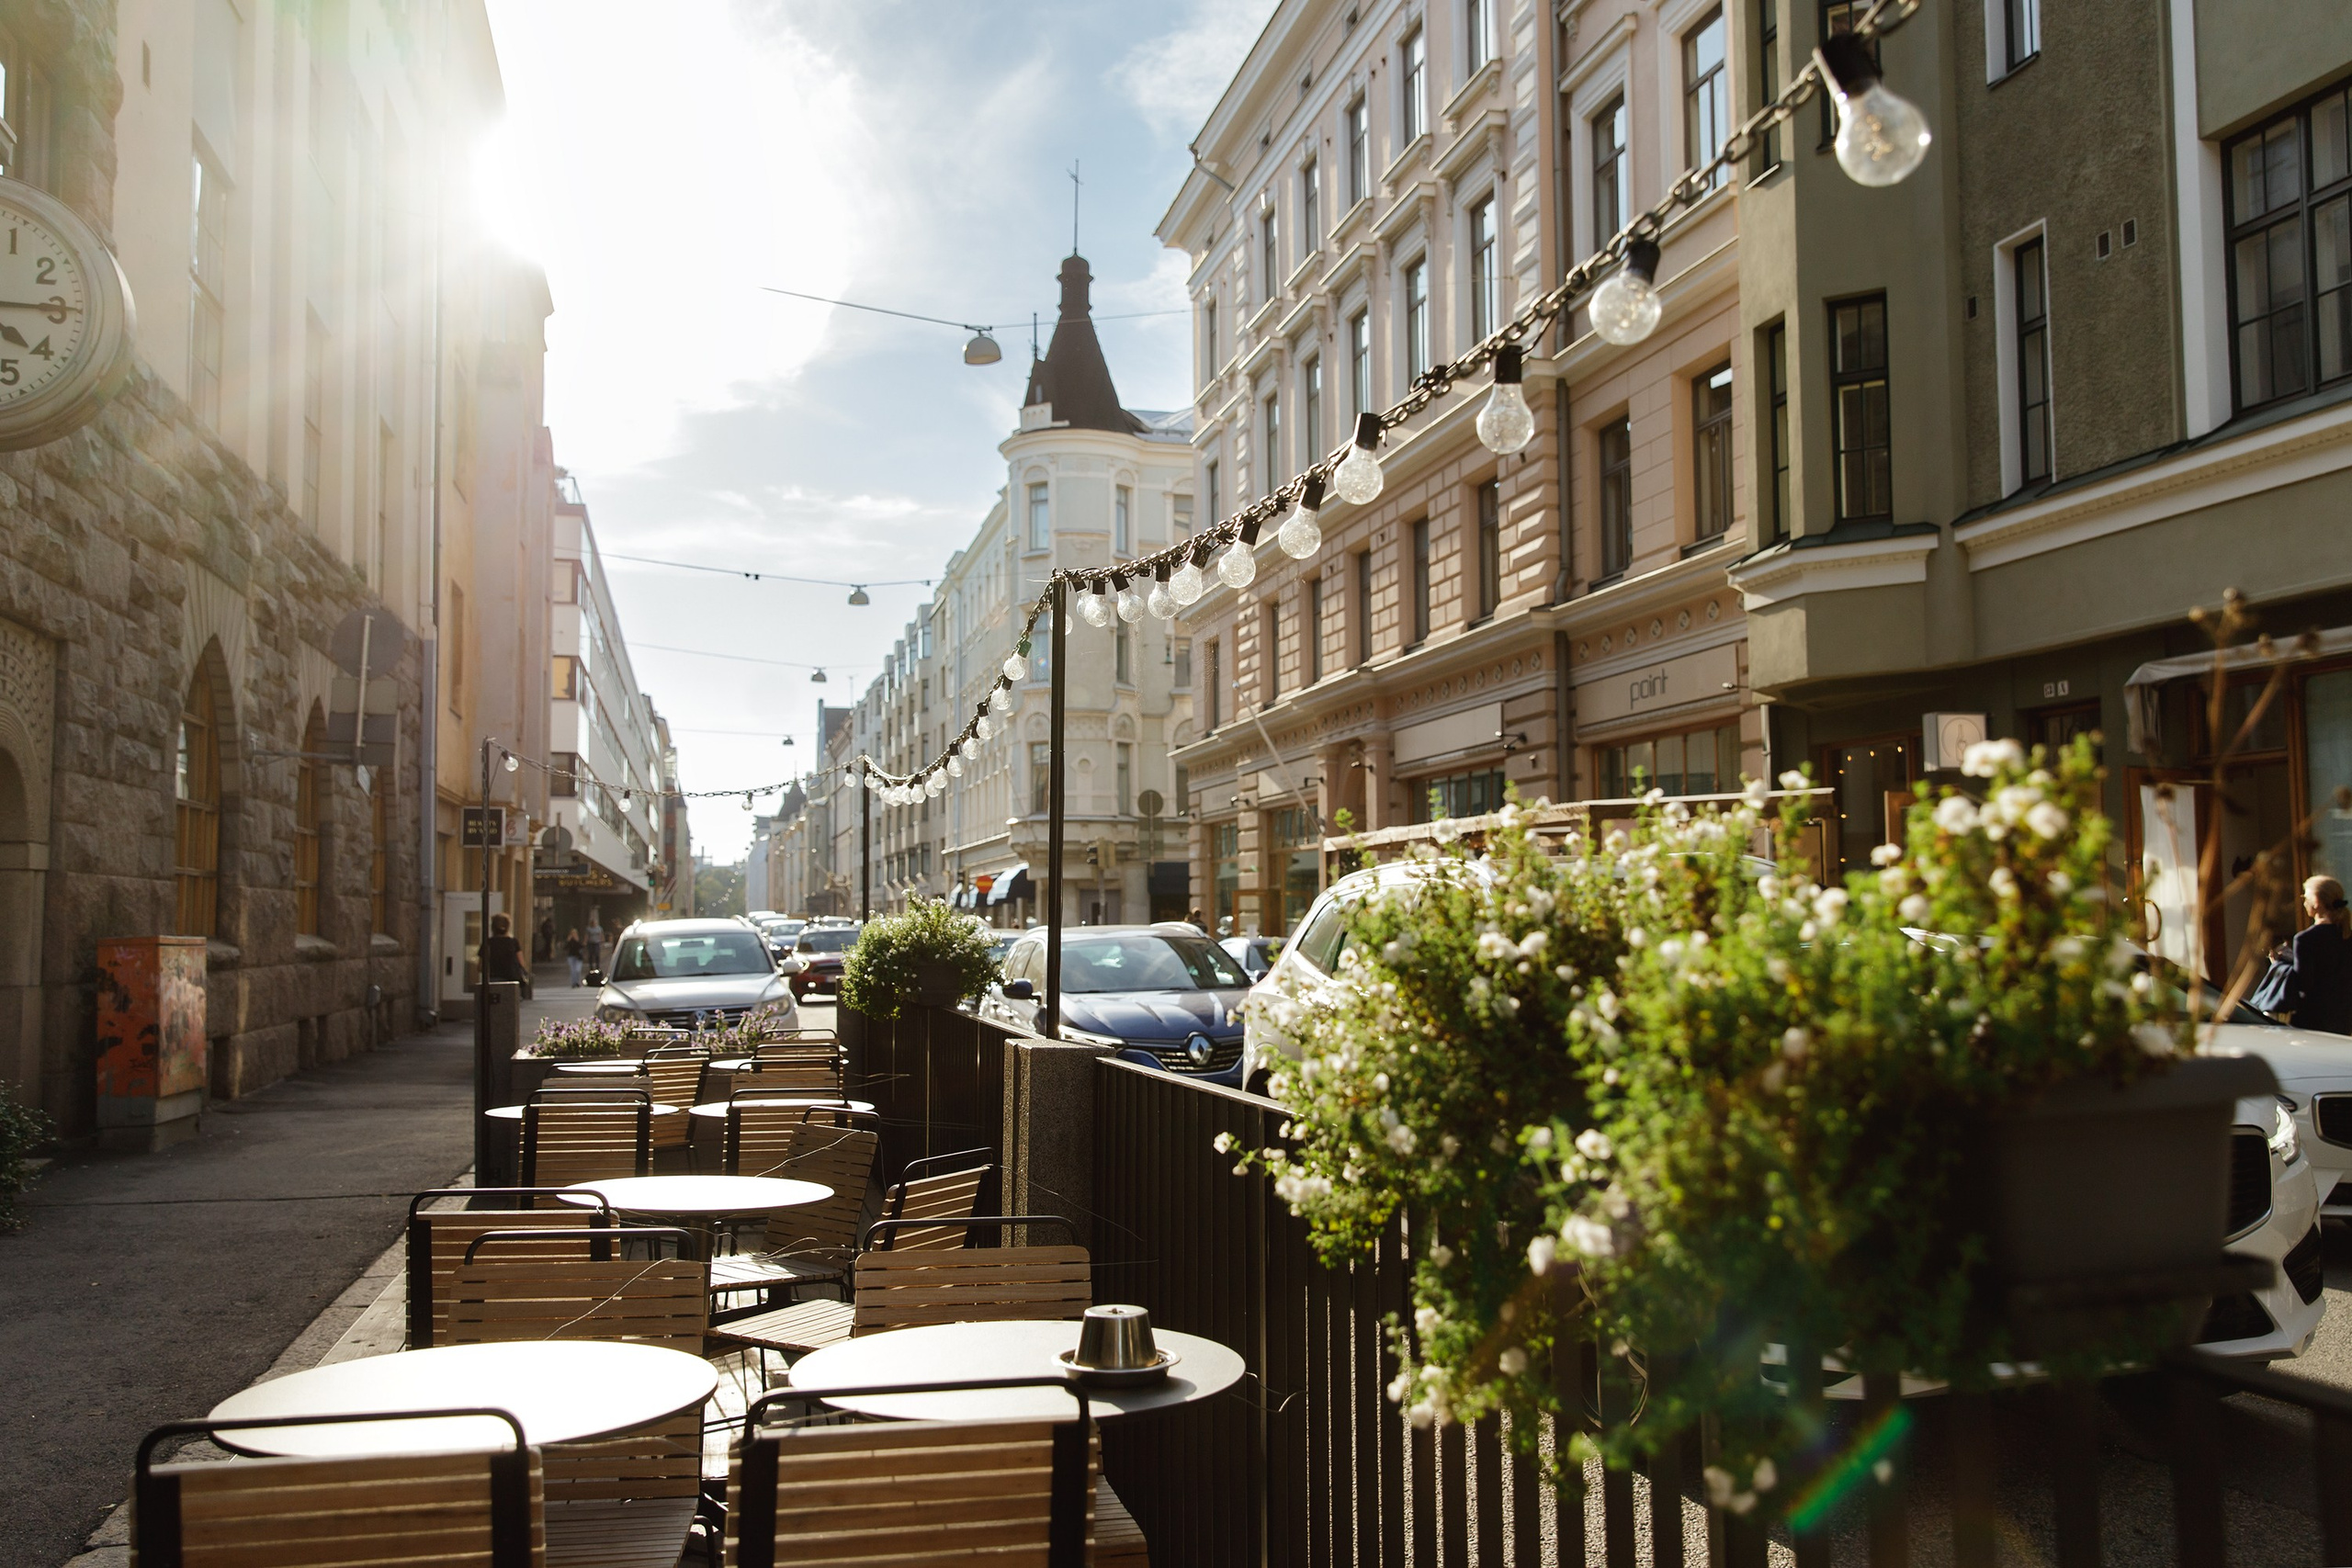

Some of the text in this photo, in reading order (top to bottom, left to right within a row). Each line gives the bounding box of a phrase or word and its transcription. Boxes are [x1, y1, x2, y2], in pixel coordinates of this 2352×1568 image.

[9, 228, 17, 254] 1
[36, 257, 57, 285] 2
[47, 296, 67, 324] 3
[28, 334, 54, 360] 4
[0, 358, 20, 386] 5
